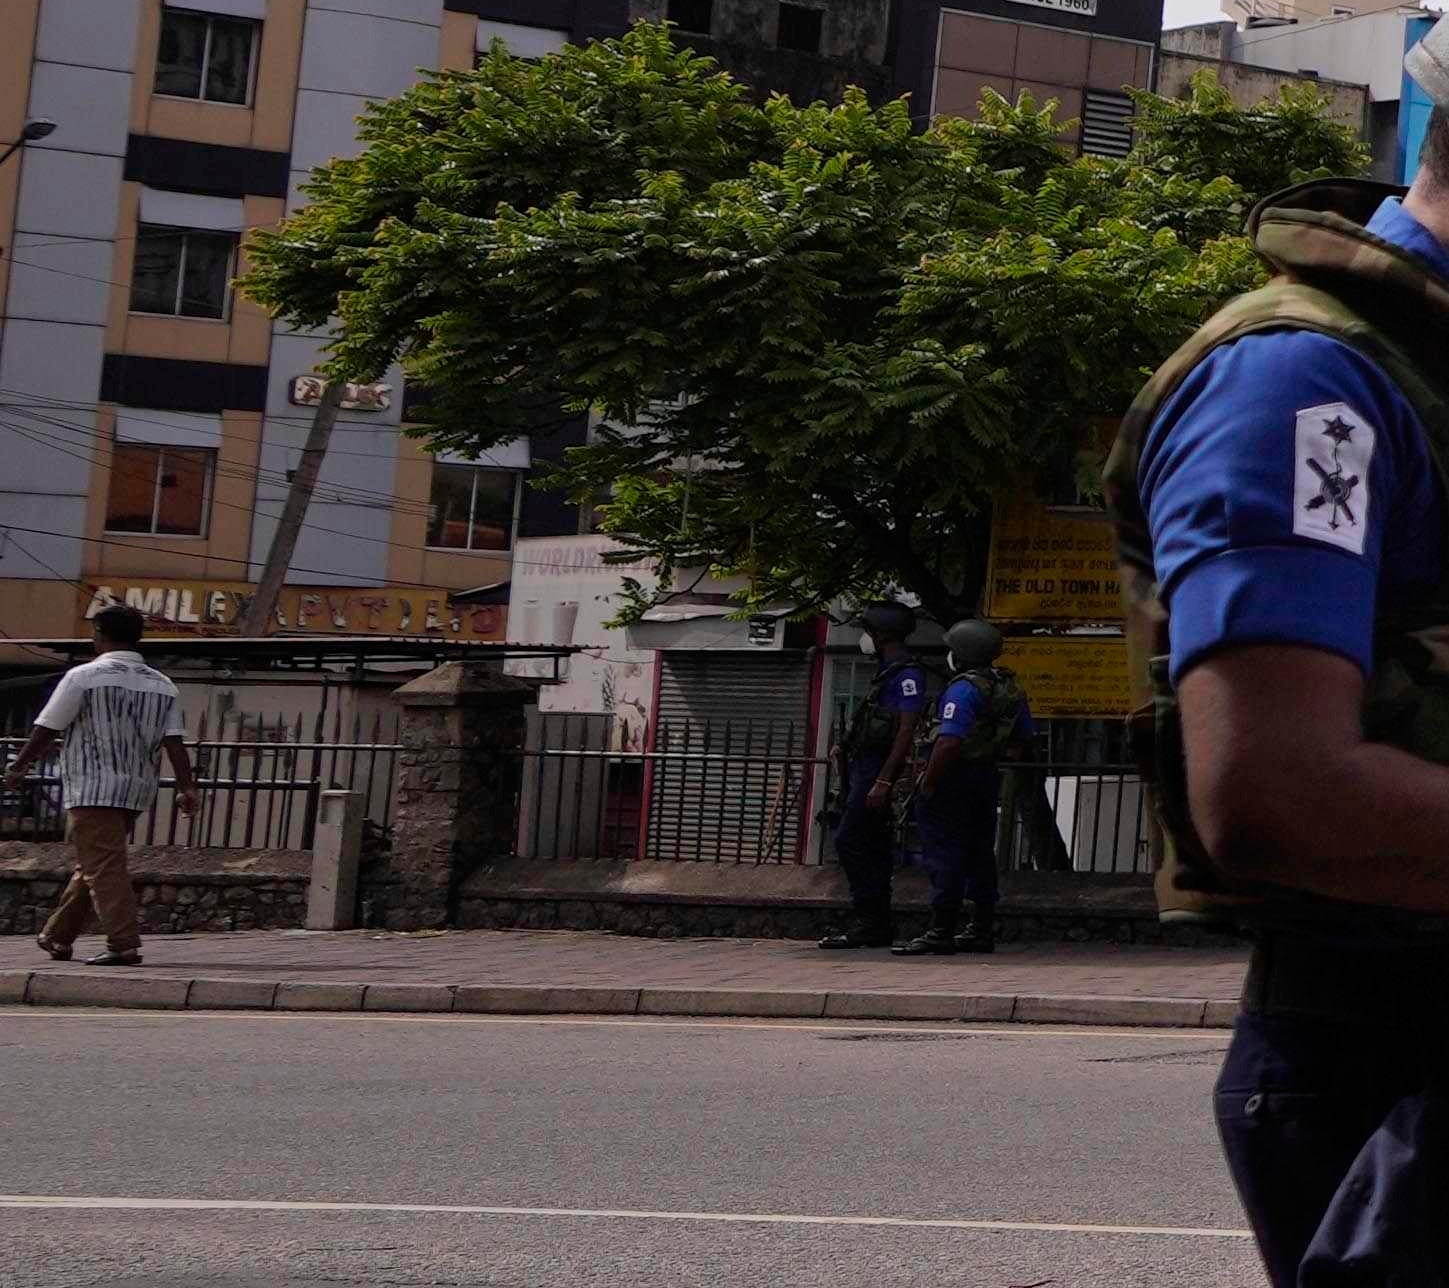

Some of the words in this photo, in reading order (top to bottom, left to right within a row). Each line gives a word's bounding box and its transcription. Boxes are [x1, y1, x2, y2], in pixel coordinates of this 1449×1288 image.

[995, 579, 1021, 595] THE
[1025, 579, 1055, 594] OLD
[1060, 579, 1100, 594] TOWN
